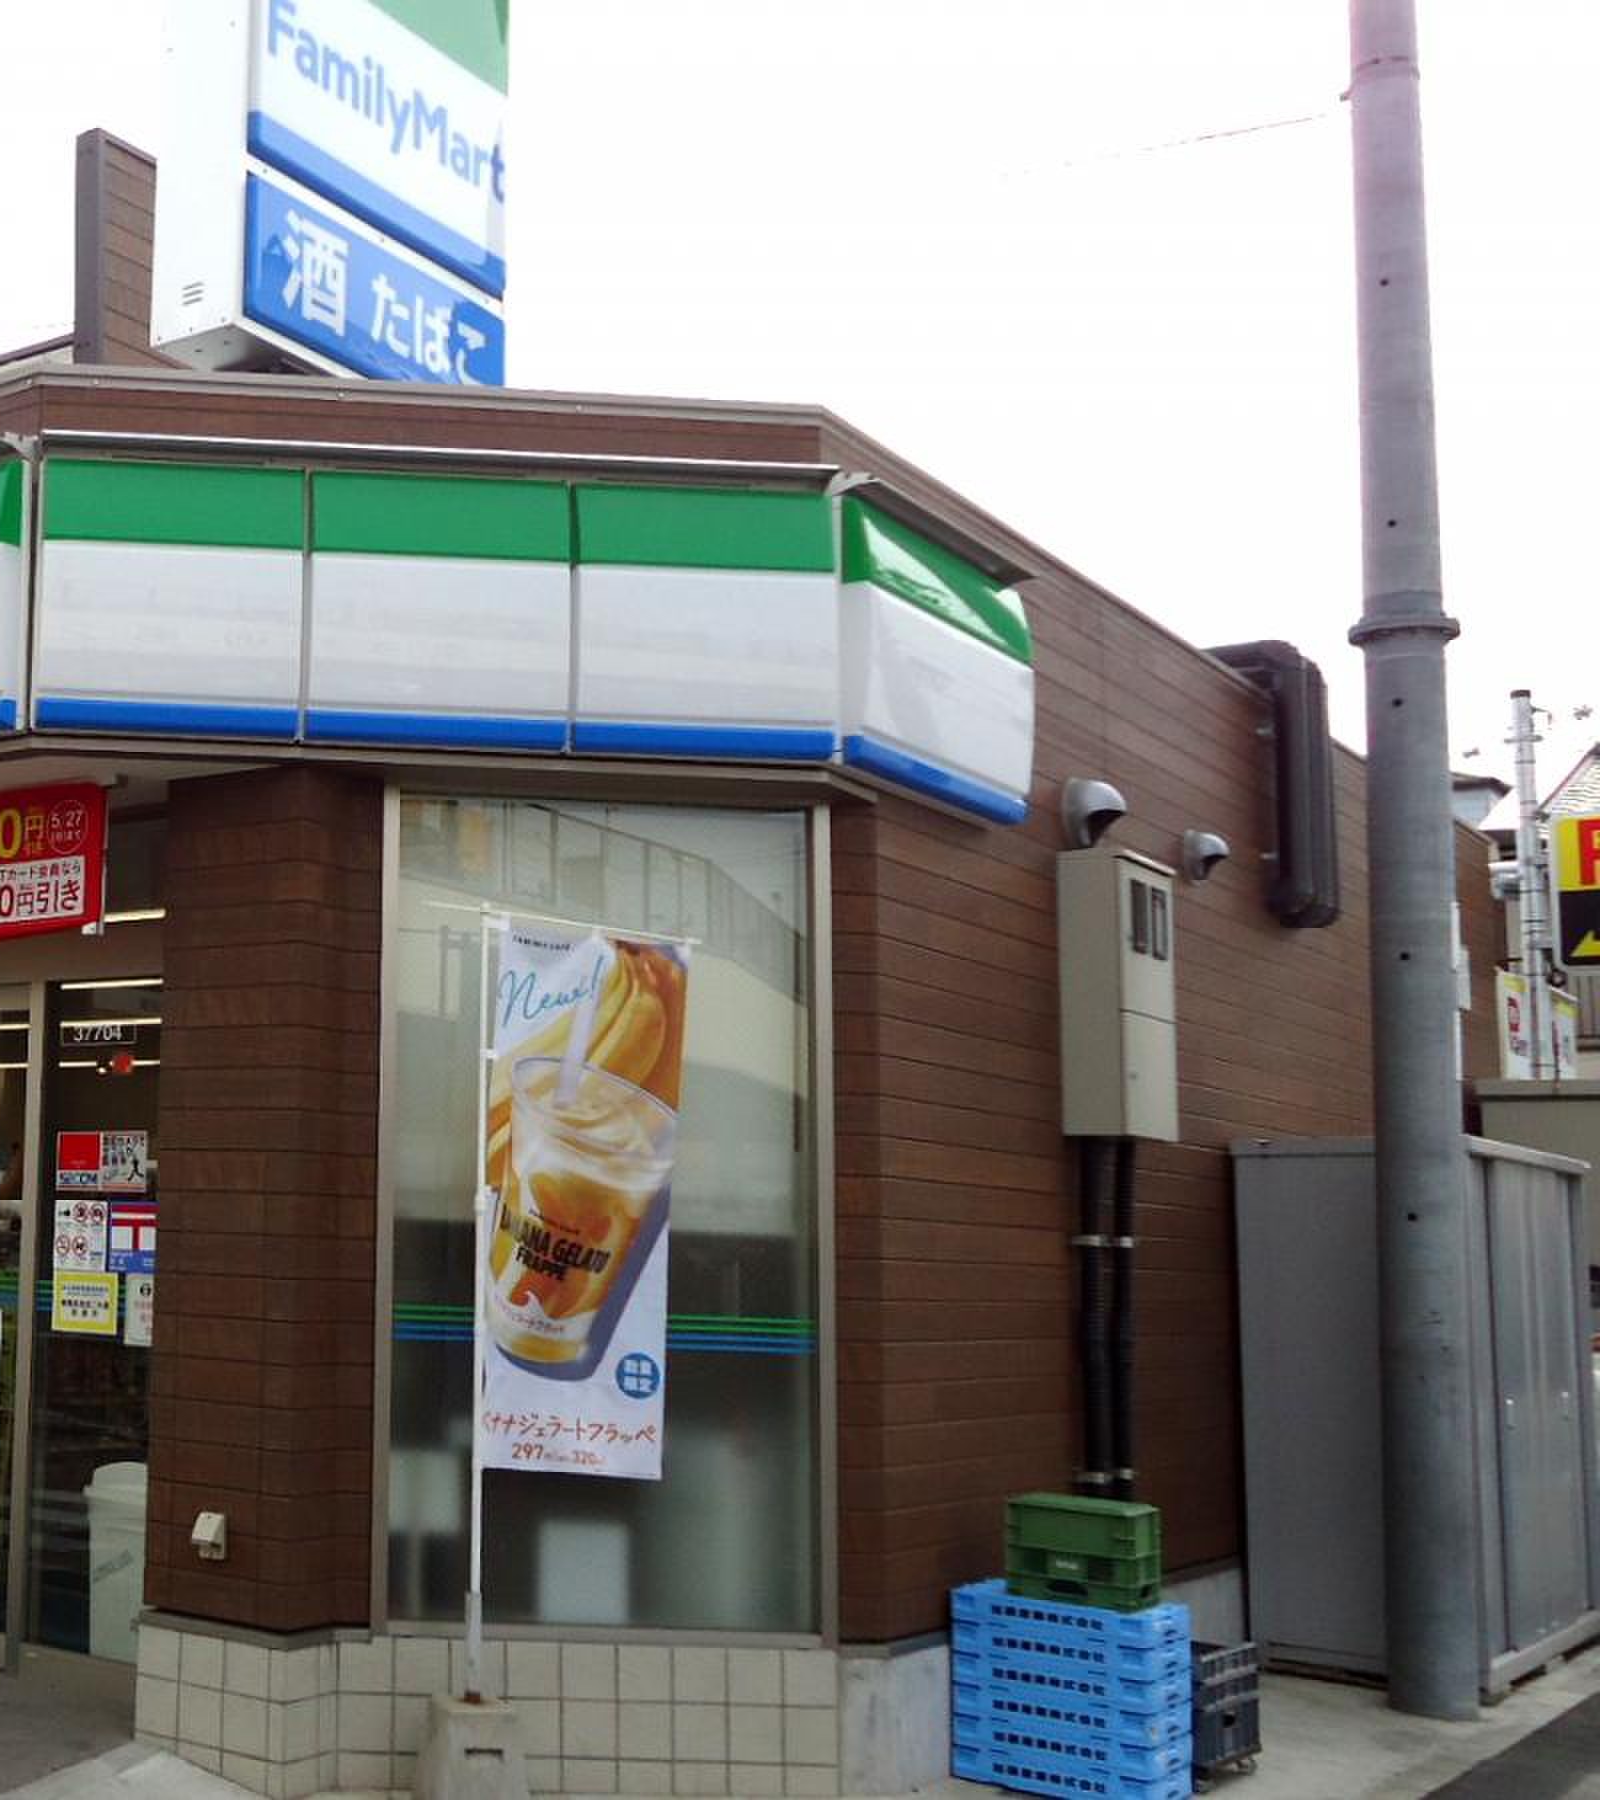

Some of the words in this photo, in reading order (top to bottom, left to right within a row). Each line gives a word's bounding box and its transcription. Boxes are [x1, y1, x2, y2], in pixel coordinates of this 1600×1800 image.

[267, 0, 505, 203] FamilyMart
[282, 209, 349, 337] 酒
[72, 1023, 122, 1041] 37704
